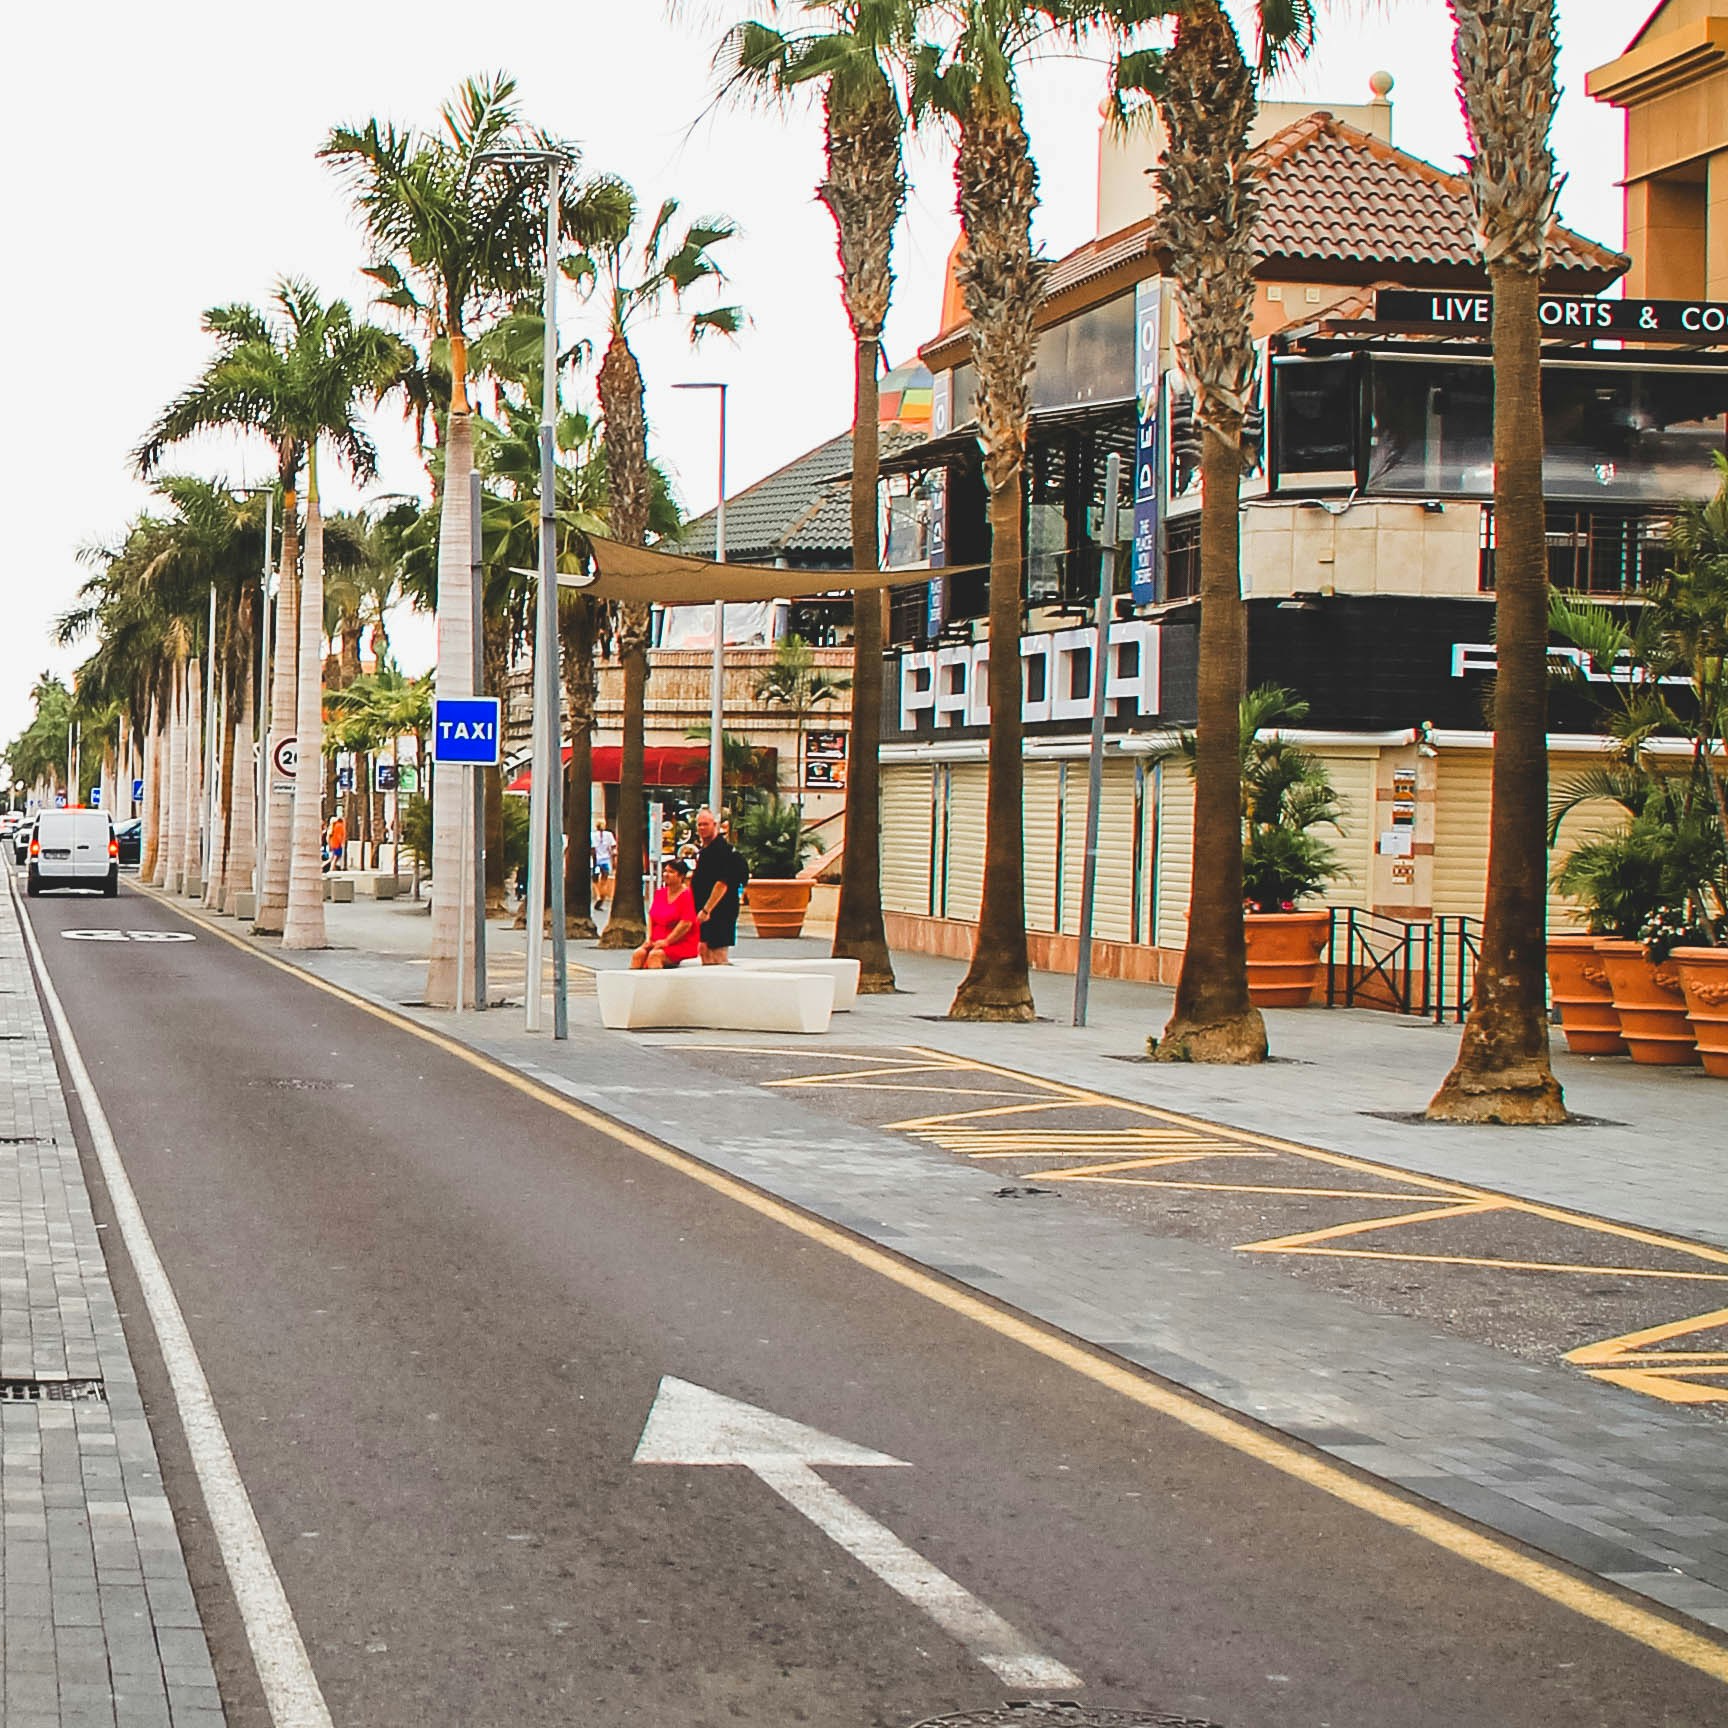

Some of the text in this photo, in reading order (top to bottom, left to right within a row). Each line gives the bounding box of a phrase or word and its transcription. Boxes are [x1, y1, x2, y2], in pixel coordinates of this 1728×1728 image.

[1432, 298, 1728, 331] LIVE ORTS & CO
[1139, 320, 1156, 489] DESEO
[439, 722, 493, 740] TAXI
